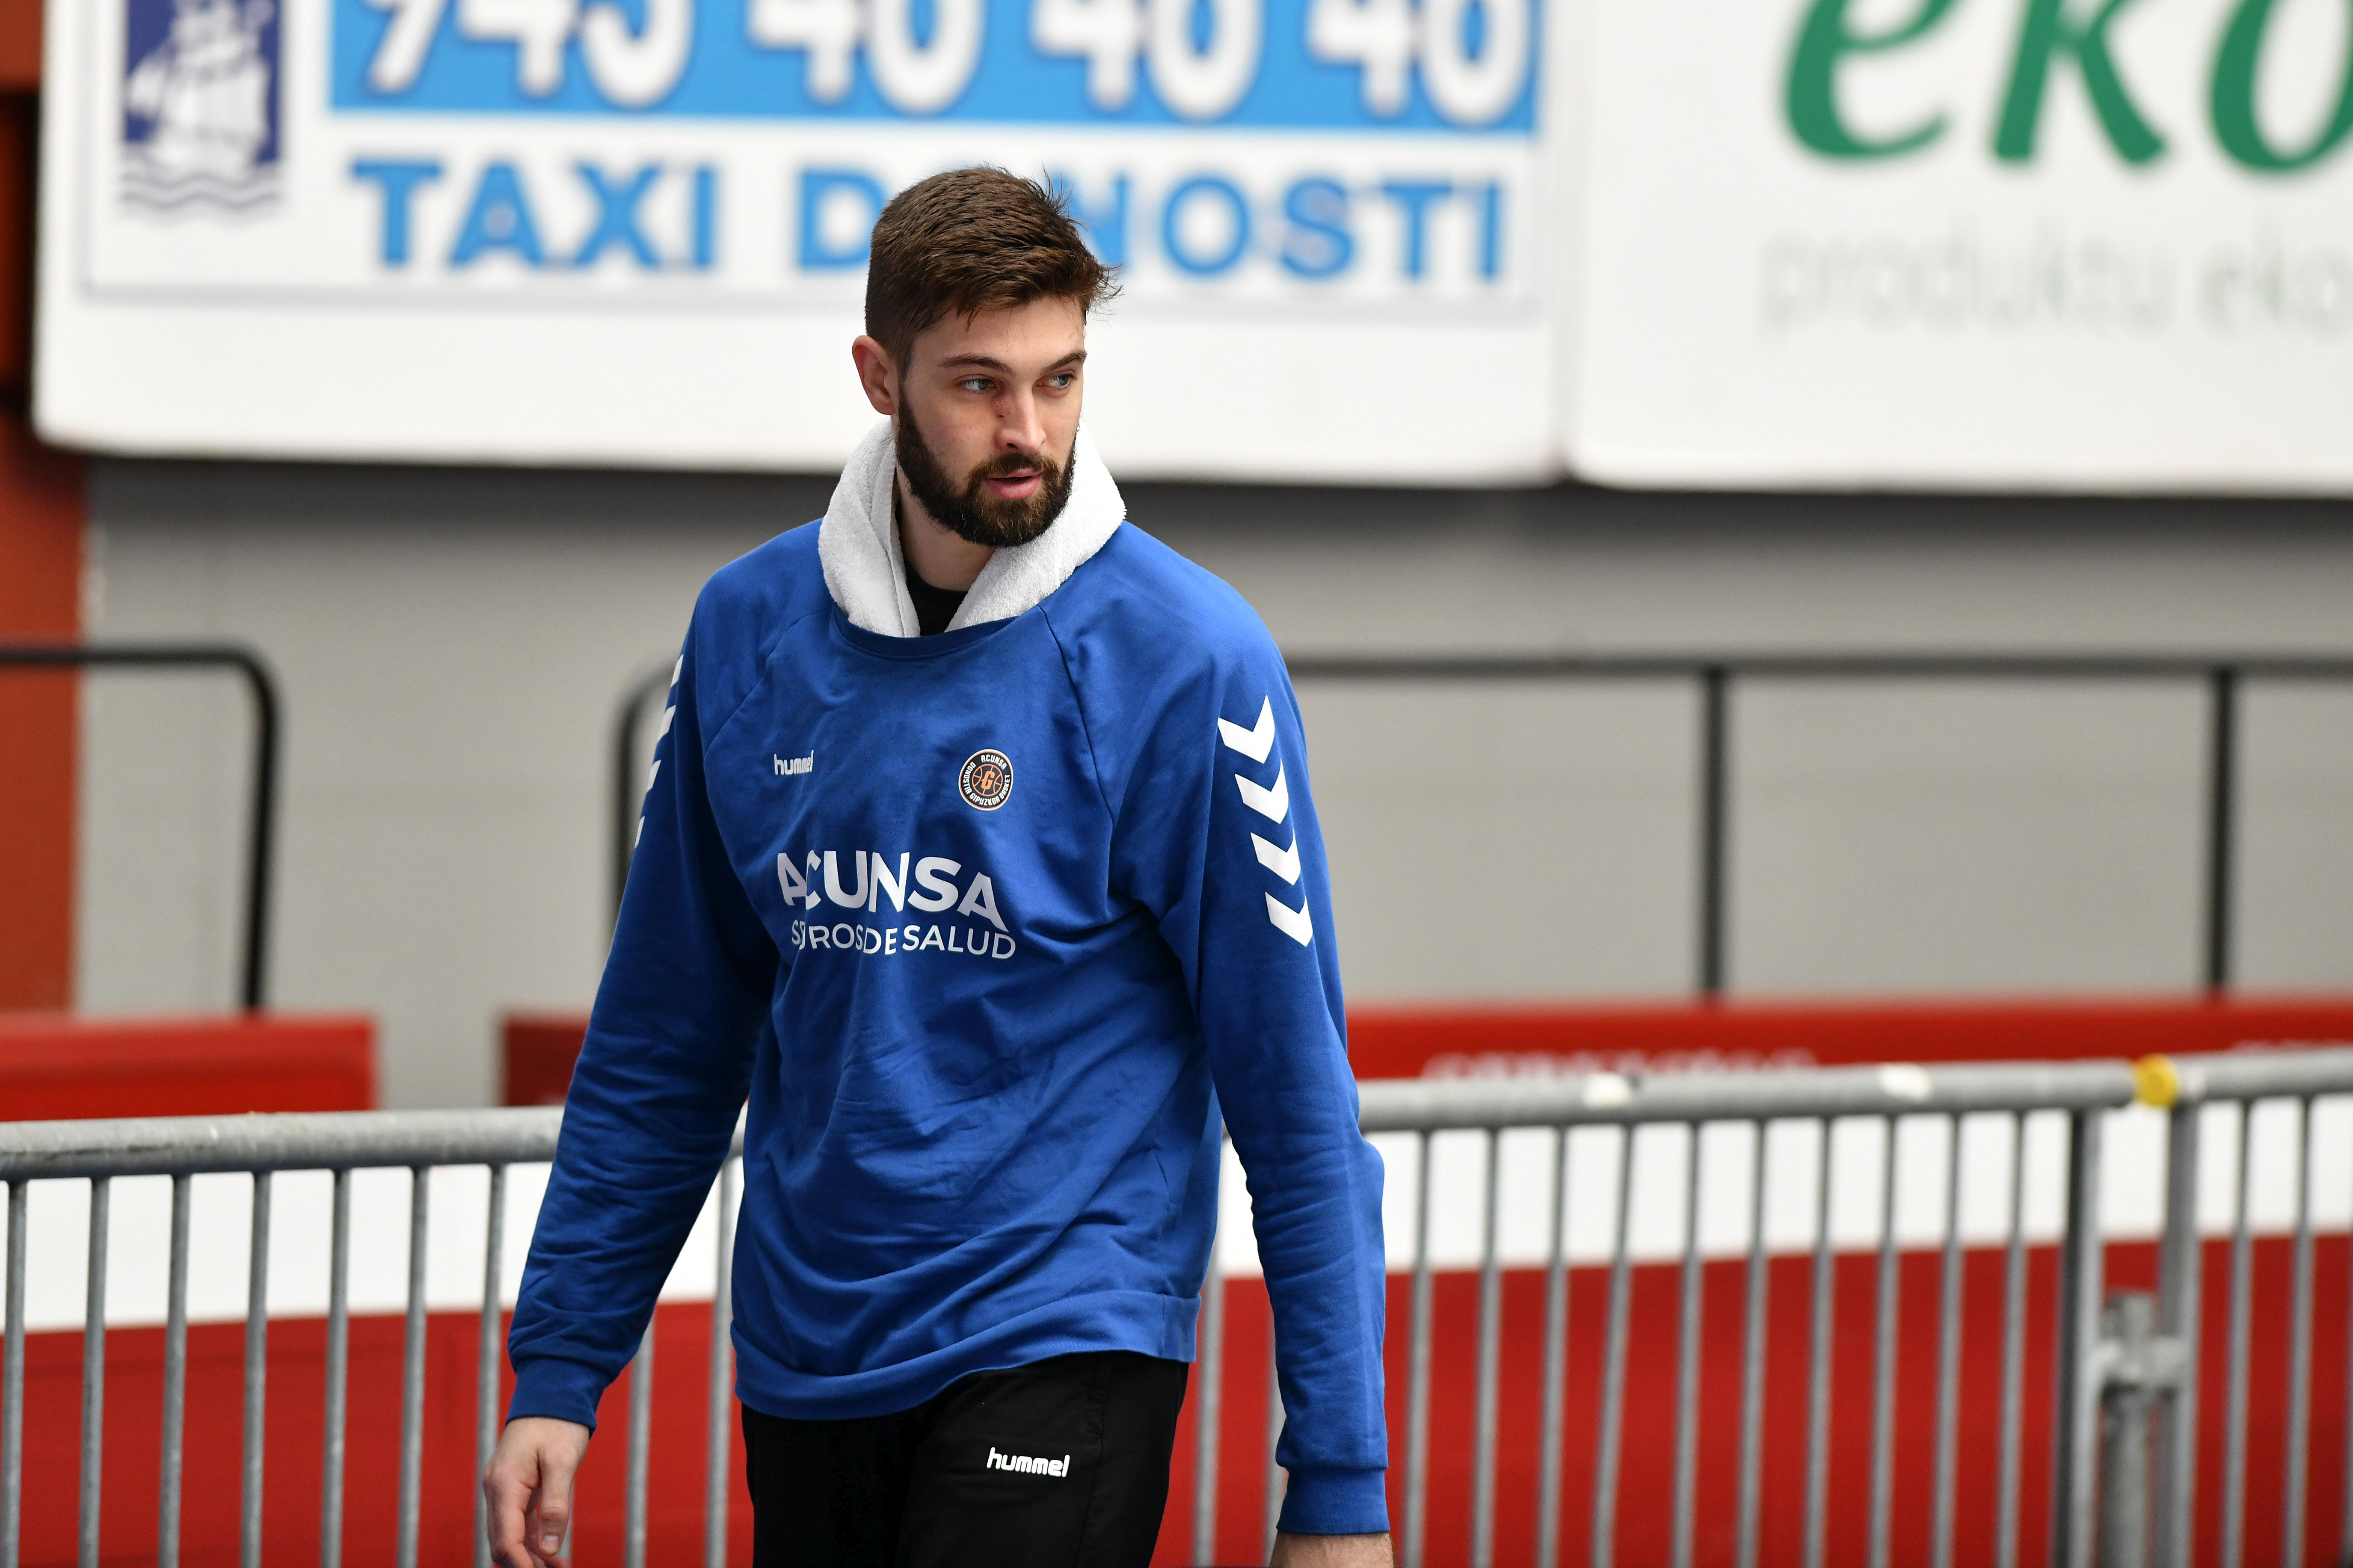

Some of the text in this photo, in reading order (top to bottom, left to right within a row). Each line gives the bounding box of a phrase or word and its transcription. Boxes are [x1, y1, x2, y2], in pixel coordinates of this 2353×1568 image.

[349, 156, 1507, 281] TAXI DNOSTI
[774, 749, 814, 775] hummel
[981, 754, 1007, 770] ACUNSA
[963, 761, 1010, 806] DONOSTIA GIPUZKOA BASKET
[777, 850, 1008, 932] ACUNSA
[902, 924, 1016, 959] SALUD
[987, 1447, 1070, 1477] hummel
